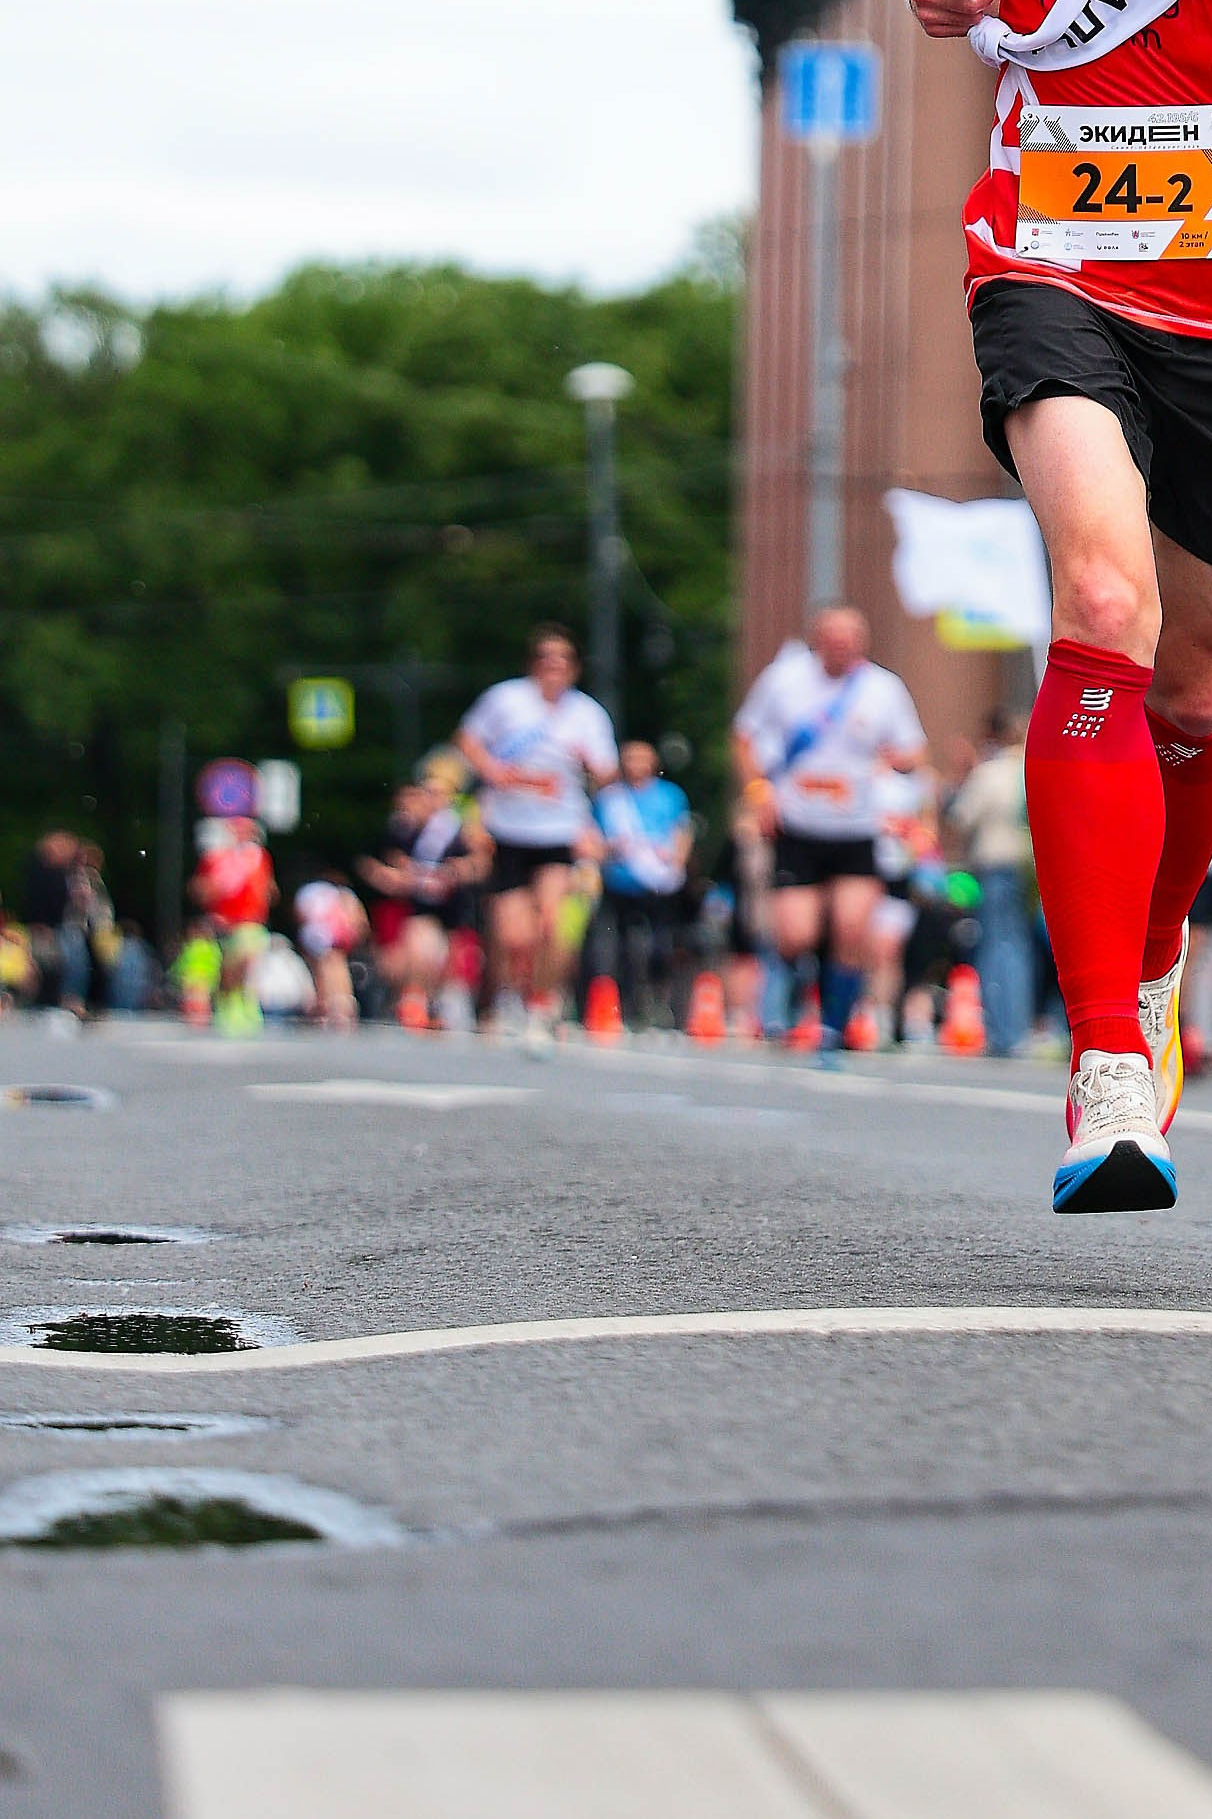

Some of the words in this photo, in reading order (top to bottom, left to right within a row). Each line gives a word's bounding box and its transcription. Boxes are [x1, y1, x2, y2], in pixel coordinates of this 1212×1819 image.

[1079, 124, 1199, 146] ЭКИДЕН
[1072, 162, 1194, 214] 24-2
[1181, 232, 1190, 240] 10
[1071, 713, 1105, 723] COMP
[1062, 729, 1097, 739] PORT
